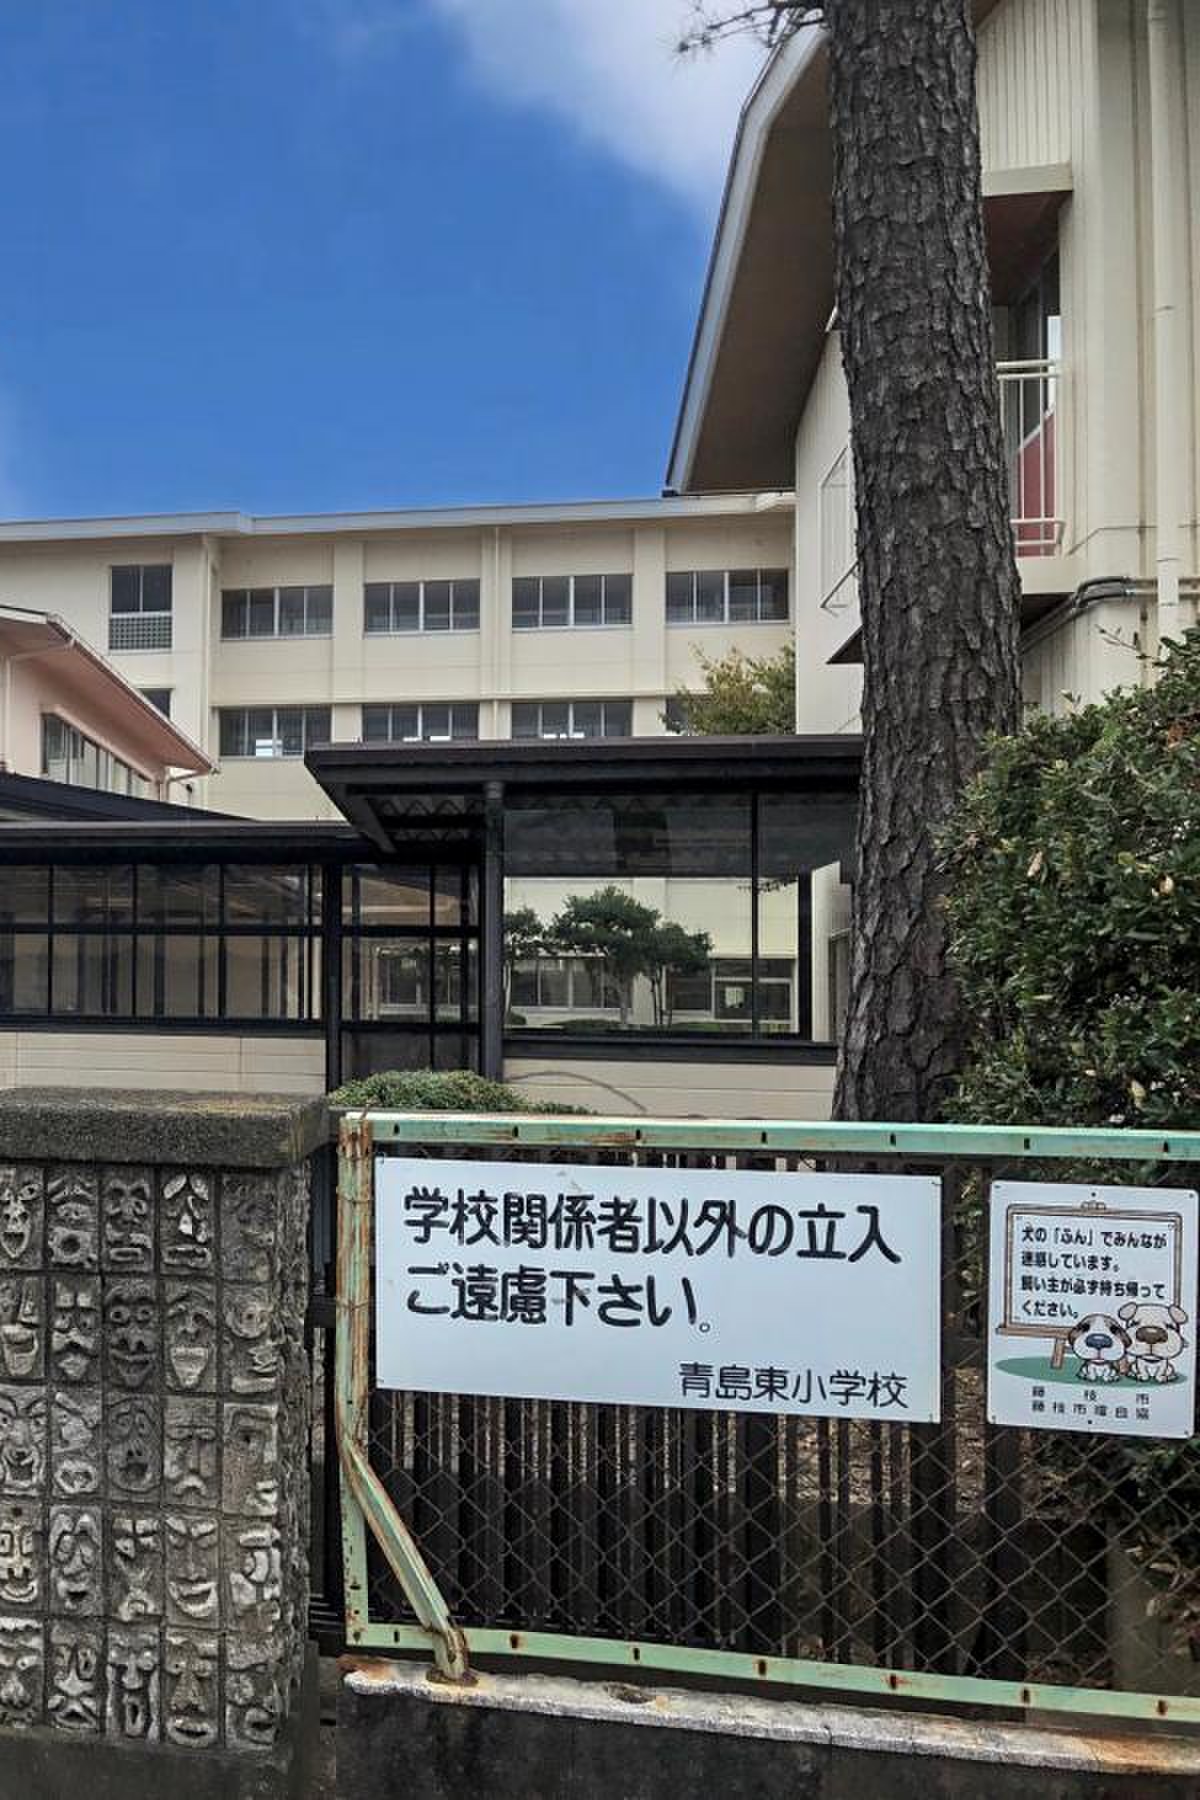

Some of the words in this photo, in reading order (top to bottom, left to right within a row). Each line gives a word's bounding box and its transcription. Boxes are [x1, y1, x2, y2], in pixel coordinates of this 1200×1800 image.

[404, 1187, 901, 1264] 学校関係者以外の立入
[407, 1263, 711, 1333] ご遠慮下さい。
[1022, 1300, 1079, 1319] ください。
[679, 1363, 908, 1408] 青島東小学校
